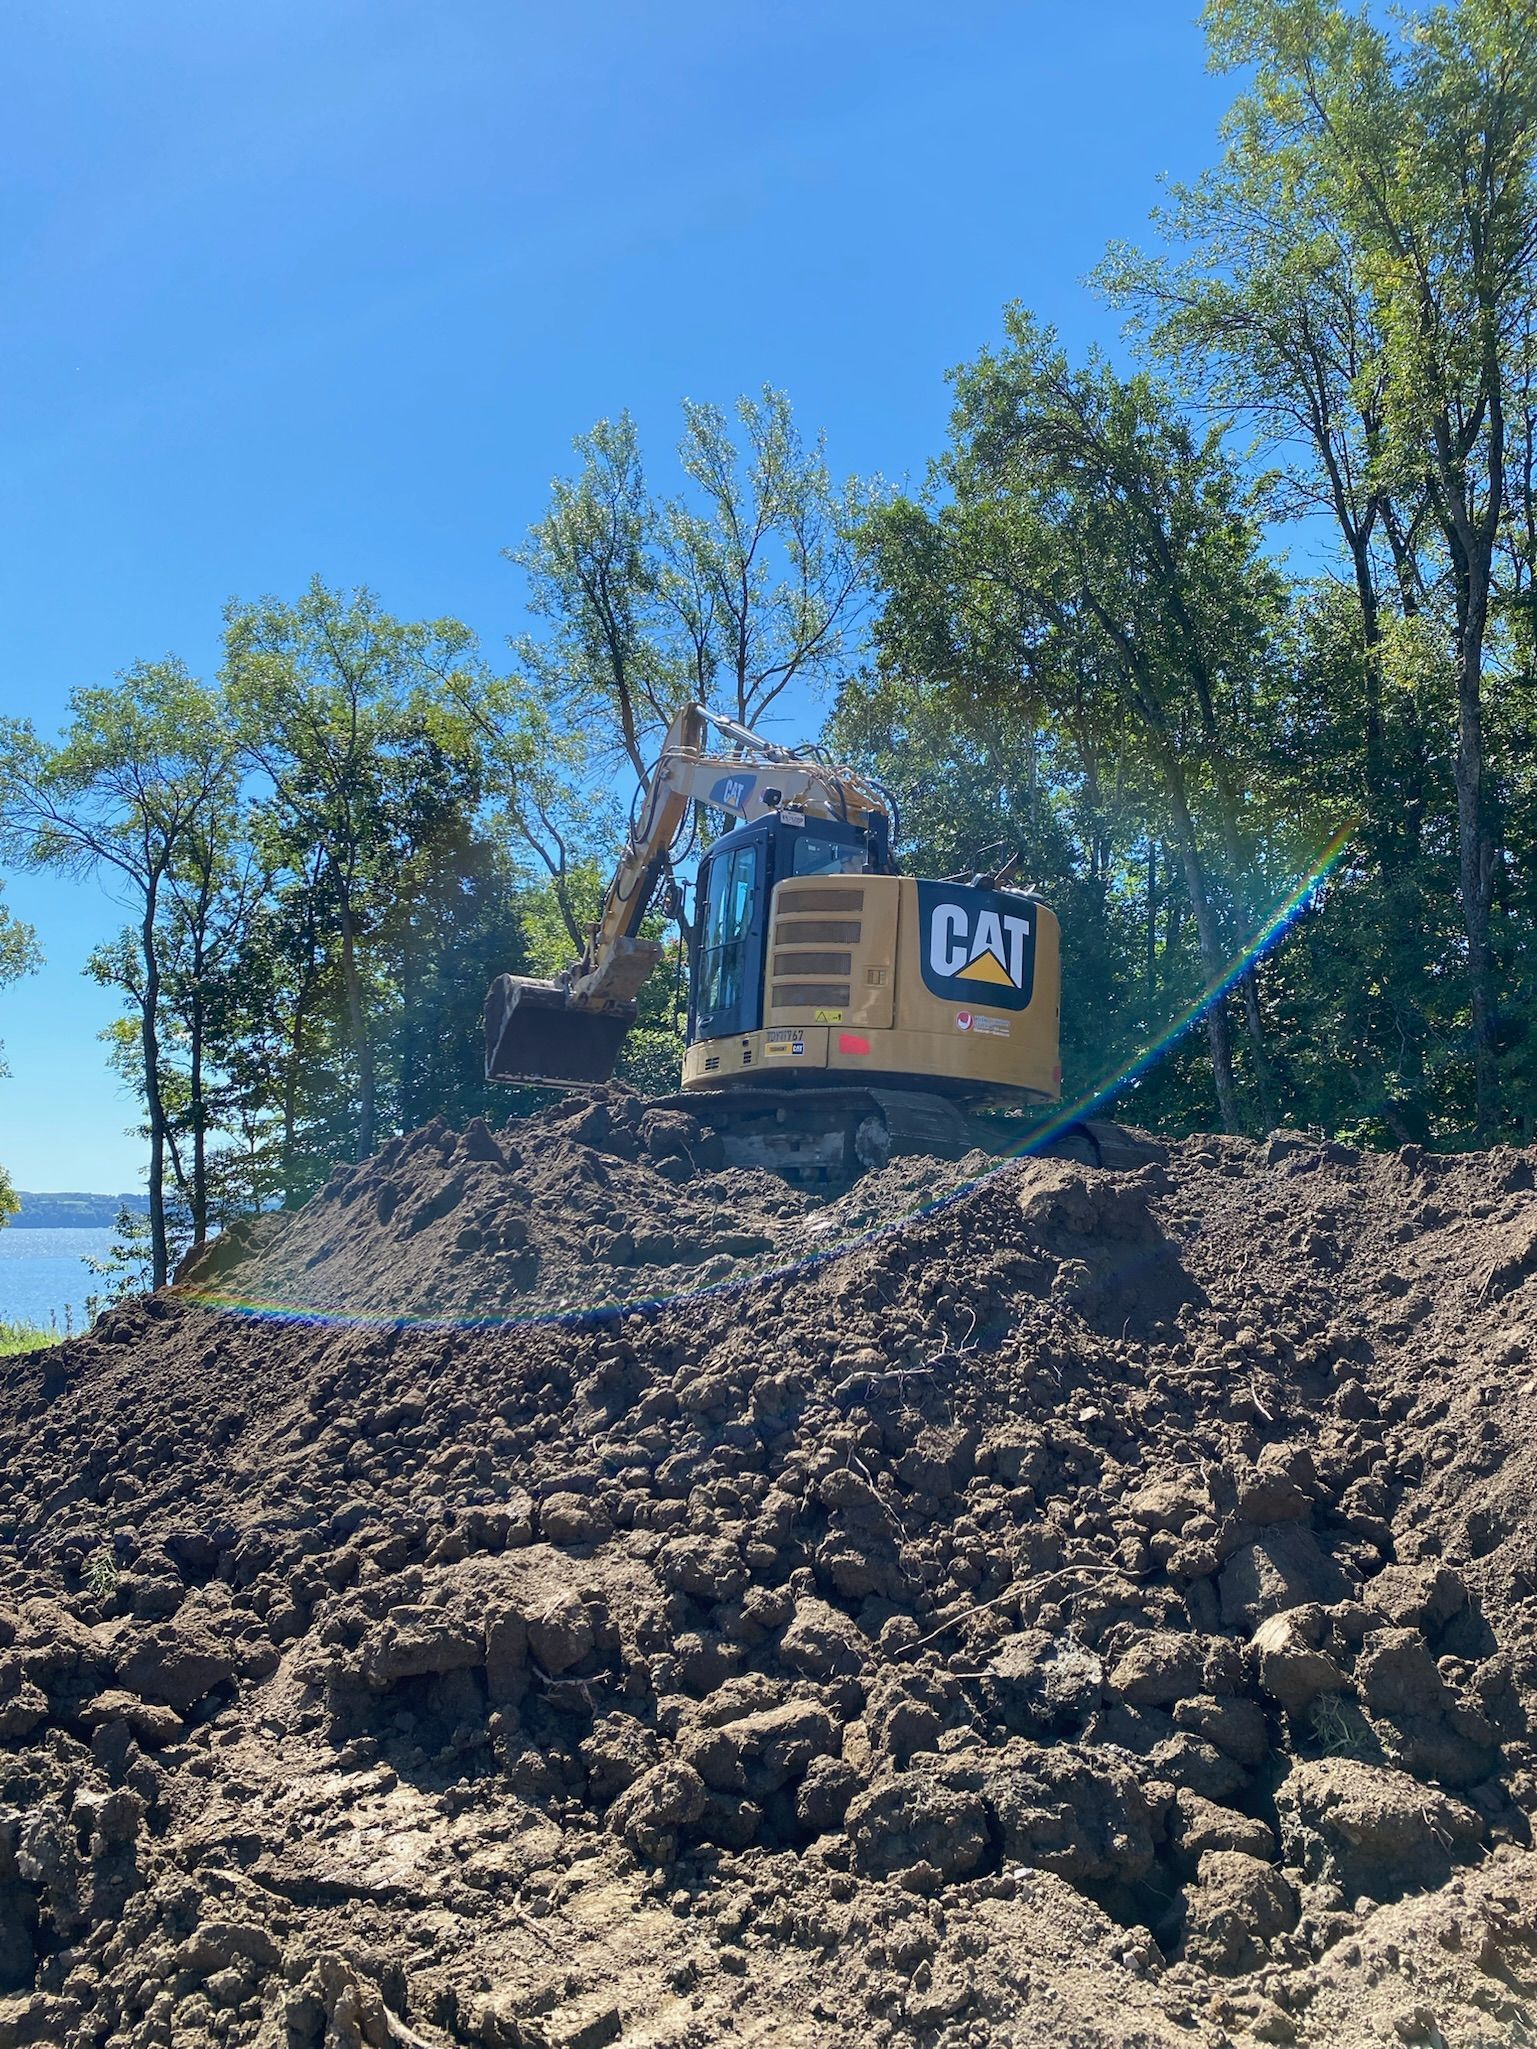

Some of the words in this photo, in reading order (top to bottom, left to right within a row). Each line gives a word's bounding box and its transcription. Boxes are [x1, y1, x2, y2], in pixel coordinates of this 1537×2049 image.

[723, 779, 745, 808] CAT
[930, 903, 1029, 989] CAT
[792, 1044, 803, 1052] CAT
